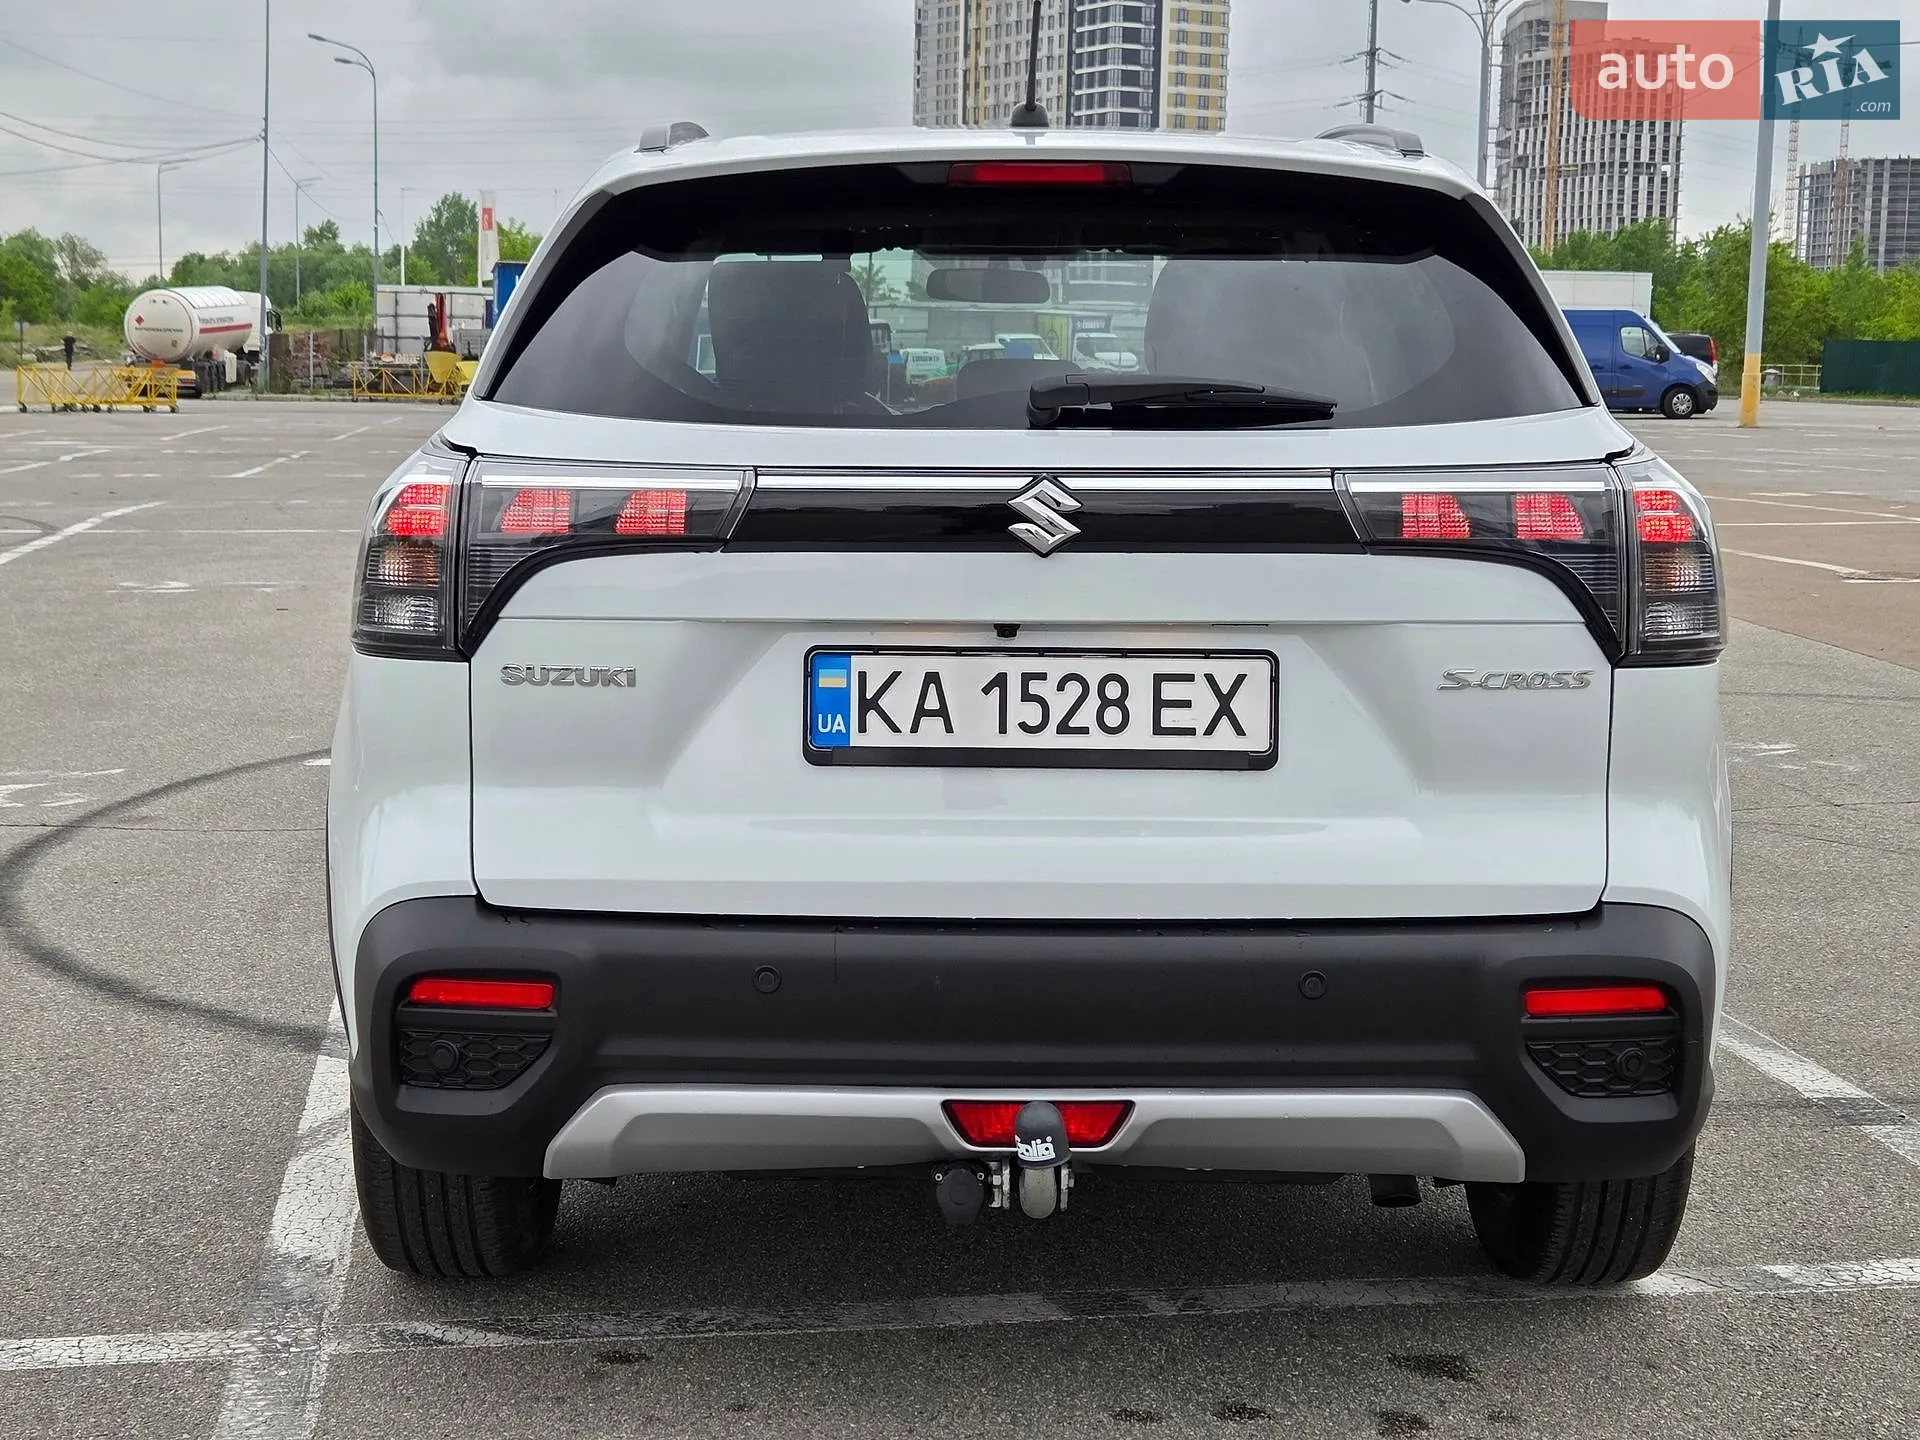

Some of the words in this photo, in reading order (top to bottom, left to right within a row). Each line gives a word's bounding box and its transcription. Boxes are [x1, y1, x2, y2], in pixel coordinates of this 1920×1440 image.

[500, 663, 636, 688] SUZUKI
[1437, 668, 1595, 691] S-CROSS
[857, 670, 954, 735] KA
[980, 671, 1131, 736] 1528
[1152, 672, 1248, 737] EX
[817, 713, 847, 734] UA
